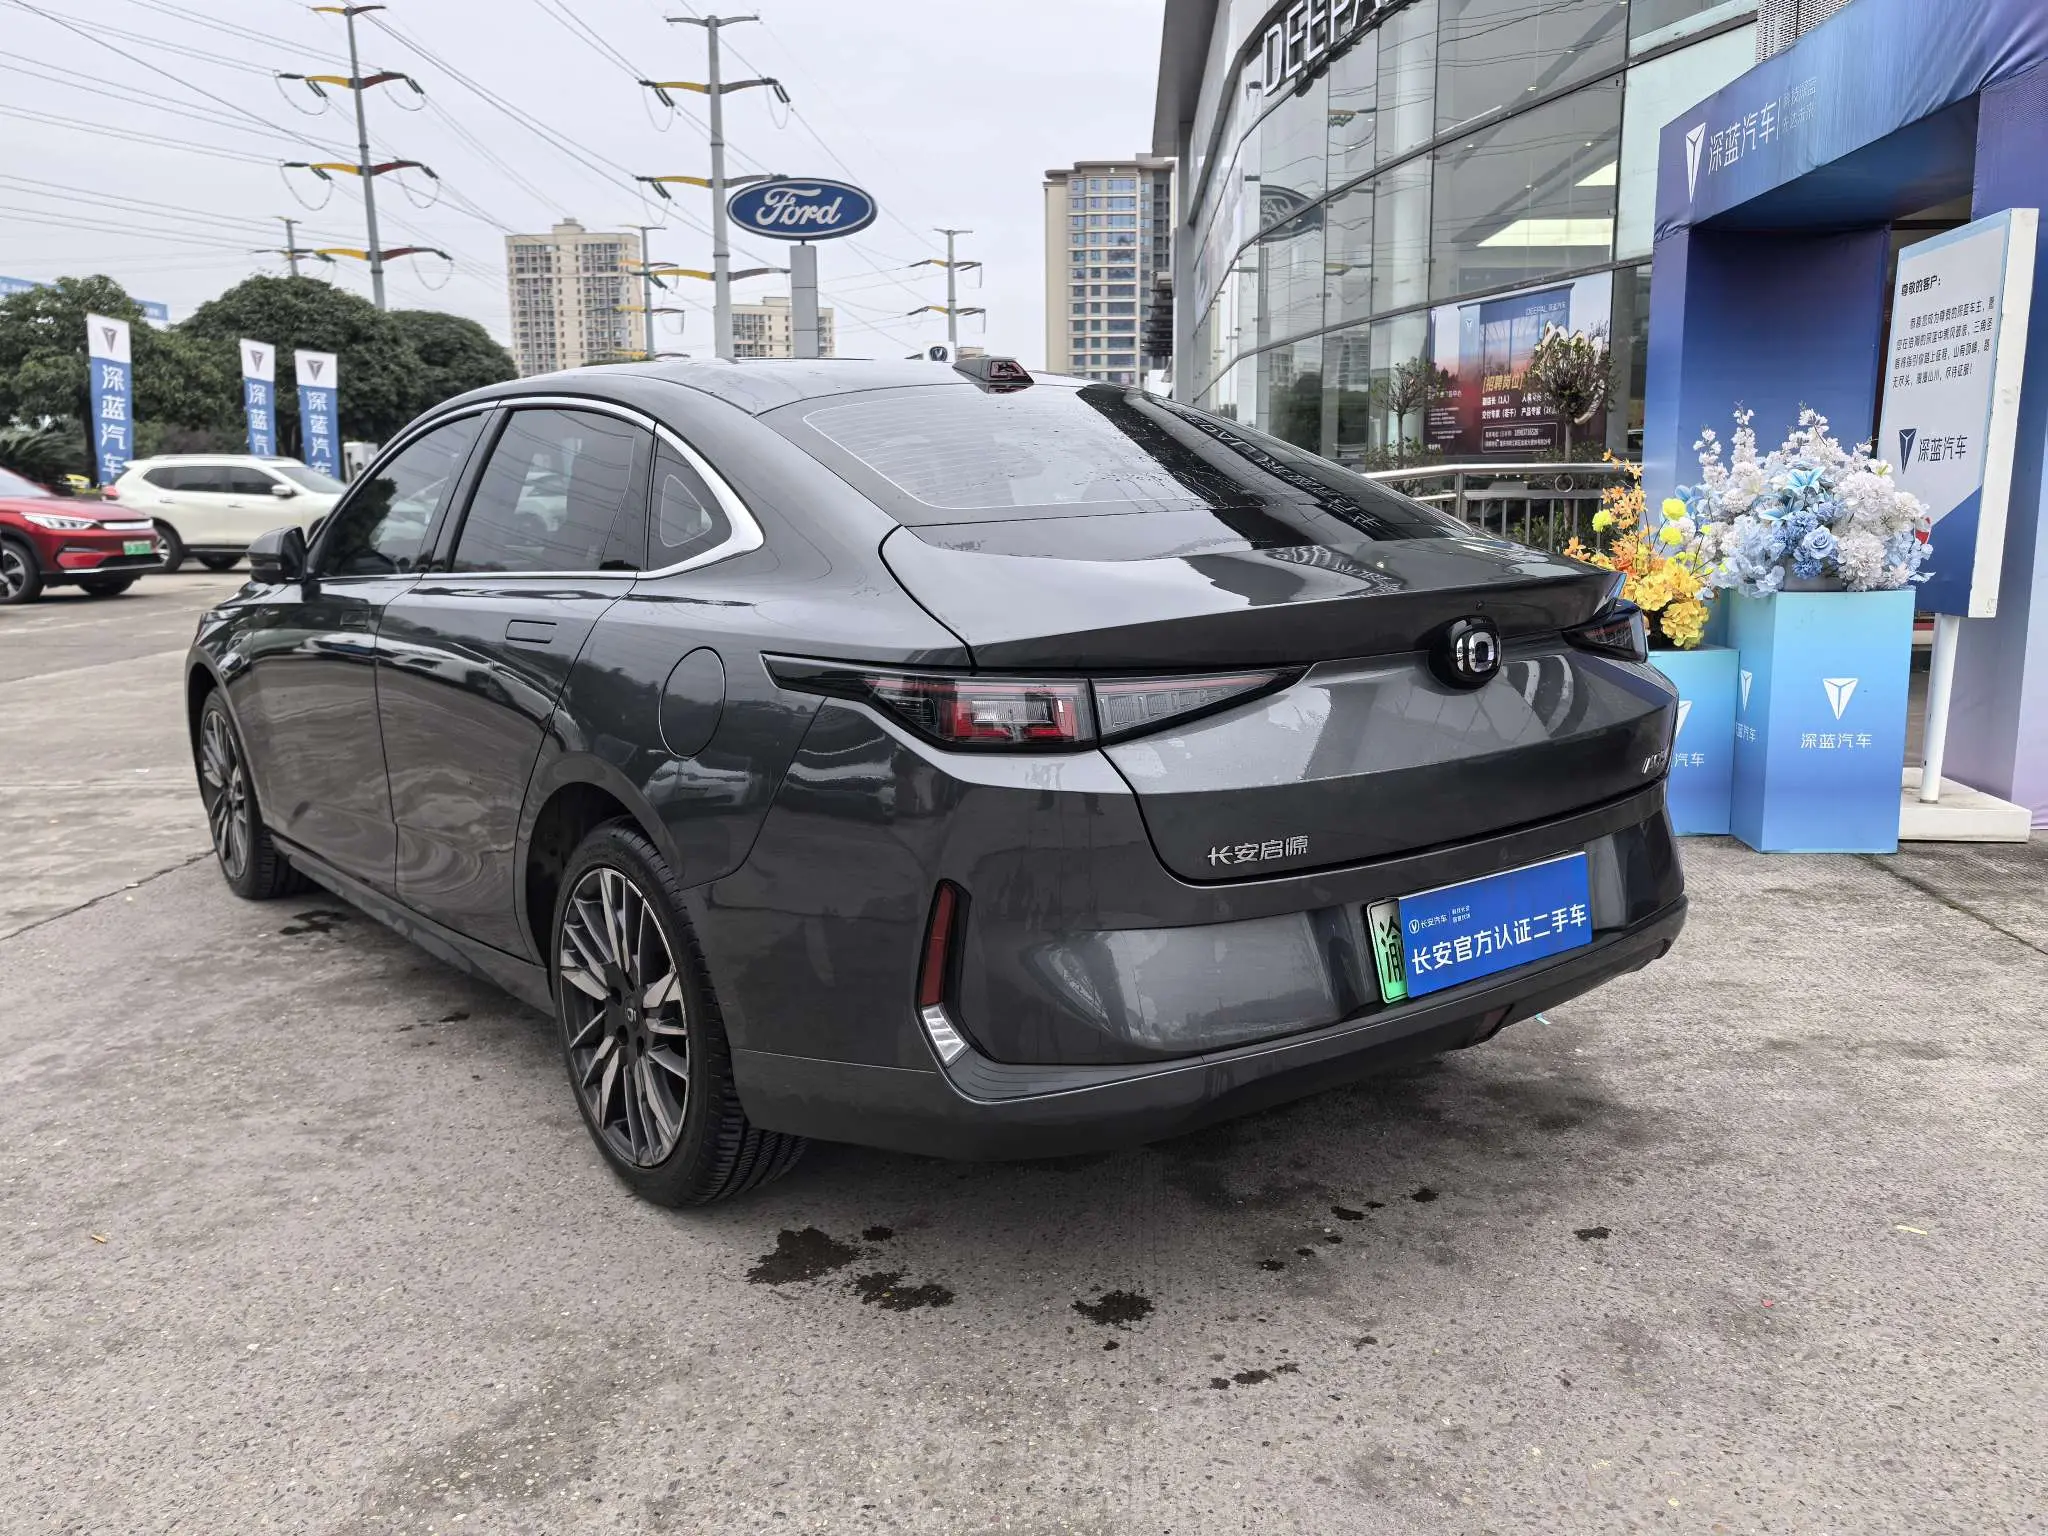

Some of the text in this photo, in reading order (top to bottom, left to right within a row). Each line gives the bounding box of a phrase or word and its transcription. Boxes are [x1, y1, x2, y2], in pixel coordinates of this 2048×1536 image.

[1263, 0, 1398, 97] DEEP
[1708, 102, 1777, 175] 深蓝汽车
[756, 187, 843, 225] Ford
[1901, 274, 1941, 297] 尊敬的客户：
[101, 364, 126, 479] 深蓝汽车
[1917, 434, 1968, 463] 深蓝汽车
[1801, 732, 1873, 750] 深蓝汽车
[1207, 835, 1309, 866] 长安启源
[1421, 914, 1448, 929] 长安汽车
[1411, 903, 1587, 975] 长安官方认证二手车
